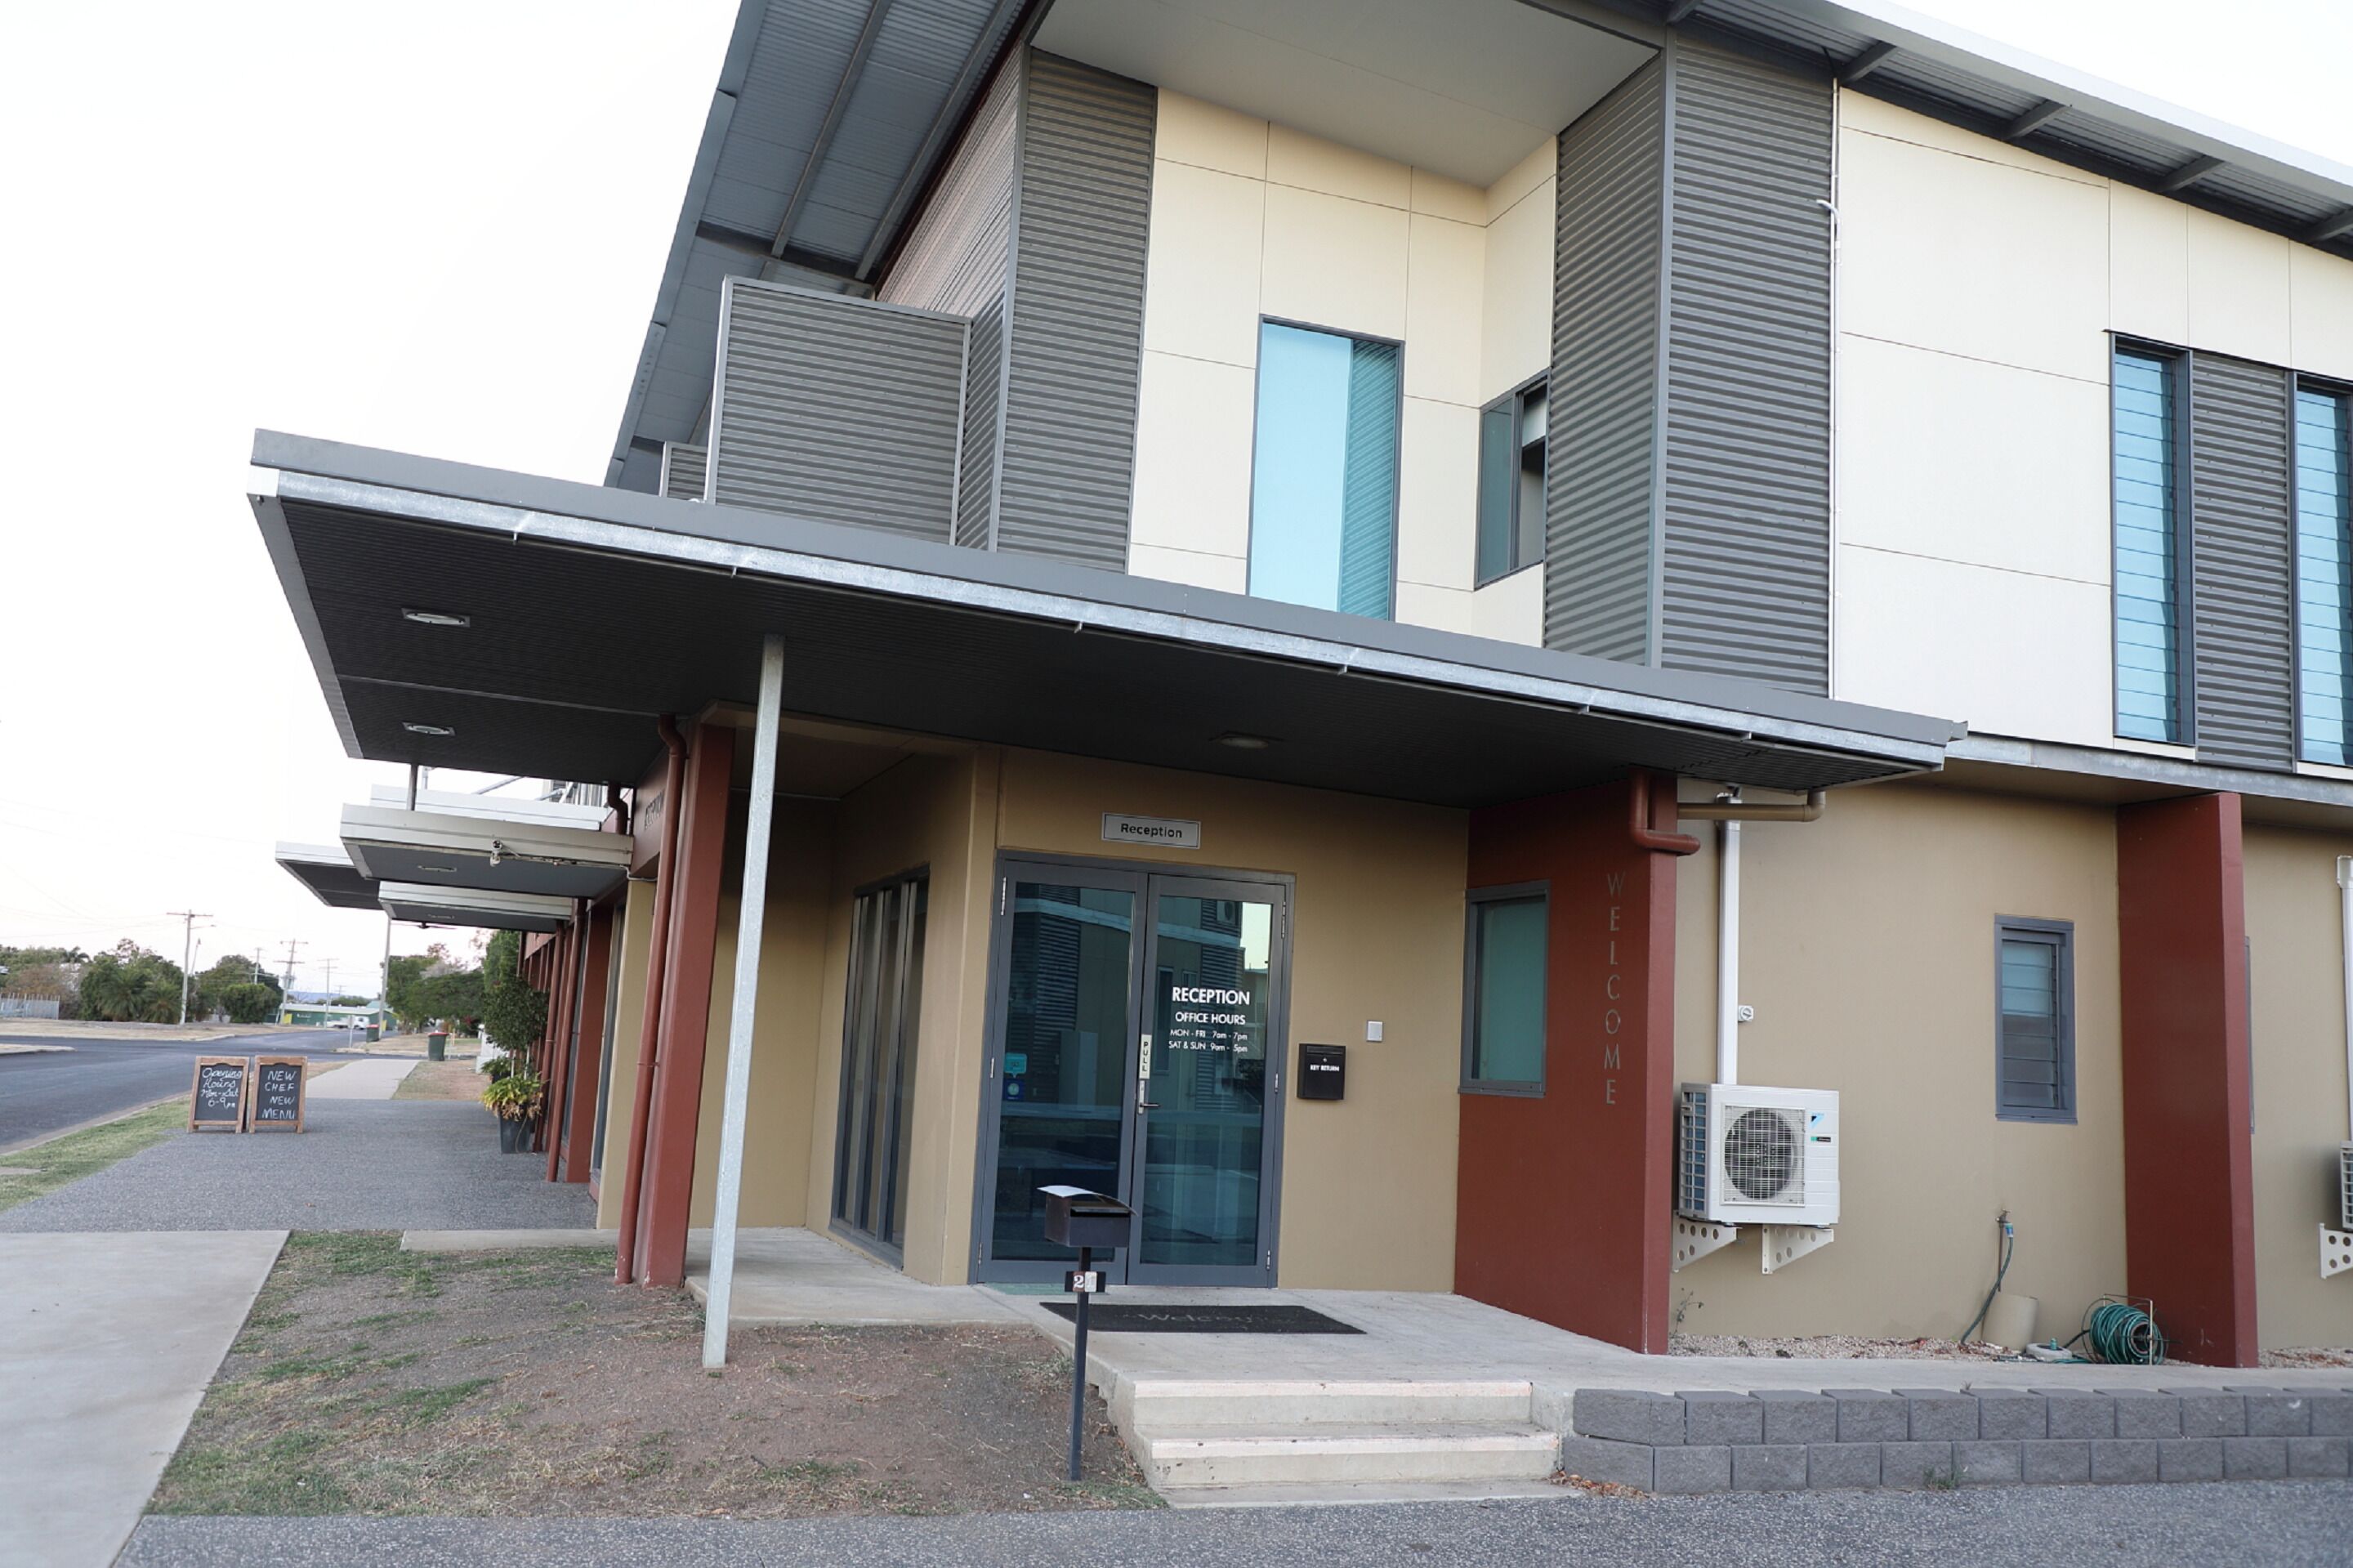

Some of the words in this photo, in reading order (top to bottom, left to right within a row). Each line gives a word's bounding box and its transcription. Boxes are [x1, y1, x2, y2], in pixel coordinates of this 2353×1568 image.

[1120, 823, 1183, 838] Reception
[1604, 871, 1626, 1105] WELCOME
[1172, 986, 1250, 1005] RECEPTION
[1175, 1011, 1209, 1023] OFFICE
[1211, 1014, 1246, 1025] HOURS
[1170, 1029, 1190, 1038] MON
[1195, 1030, 1206, 1039] FRI
[1212, 1030, 1227, 1039] 7am
[1233, 1031, 1248, 1042] 7pm
[1168, 1041, 1182, 1049] SAT
[1183, 1041, 1189, 1049] &
[1190, 1042, 1207, 1051] SUN
[1210, 1043, 1225, 1052] 9am
[1233, 1043, 1248, 1054] 5pm
[1141, 1041, 1150, 1072] PULL
[202, 1067, 243, 1079] Opening
[267, 1070, 297, 1081] NEW
[203, 1078, 236, 1088] Hours
[264, 1082, 295, 1092] CHEF
[270, 1096, 295, 1106] NEW
[261, 1107, 295, 1119] MENU
